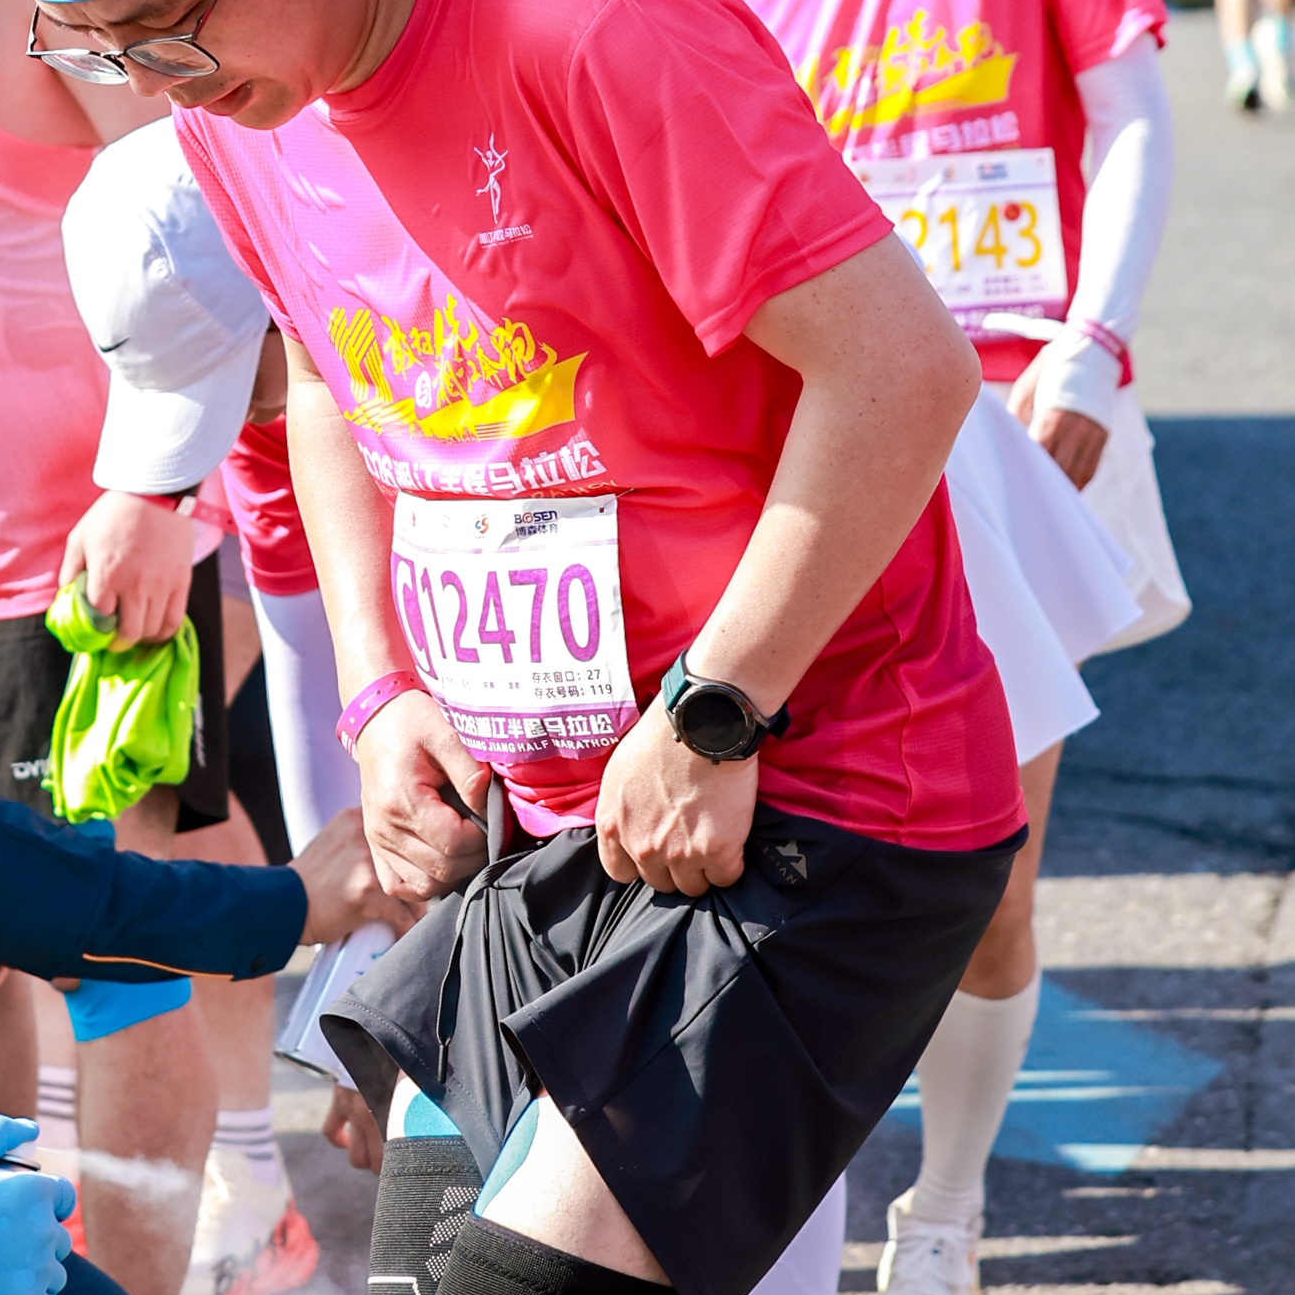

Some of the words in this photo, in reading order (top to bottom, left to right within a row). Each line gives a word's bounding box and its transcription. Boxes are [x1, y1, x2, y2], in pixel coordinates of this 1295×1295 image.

[514, 510, 558, 525] BOSEN
[515, 523, 558, 537] 博森体育
[420, 563, 601, 664] 12470
[488, 739, 516, 753] JIANG
[517, 741, 549, 753] HALF
